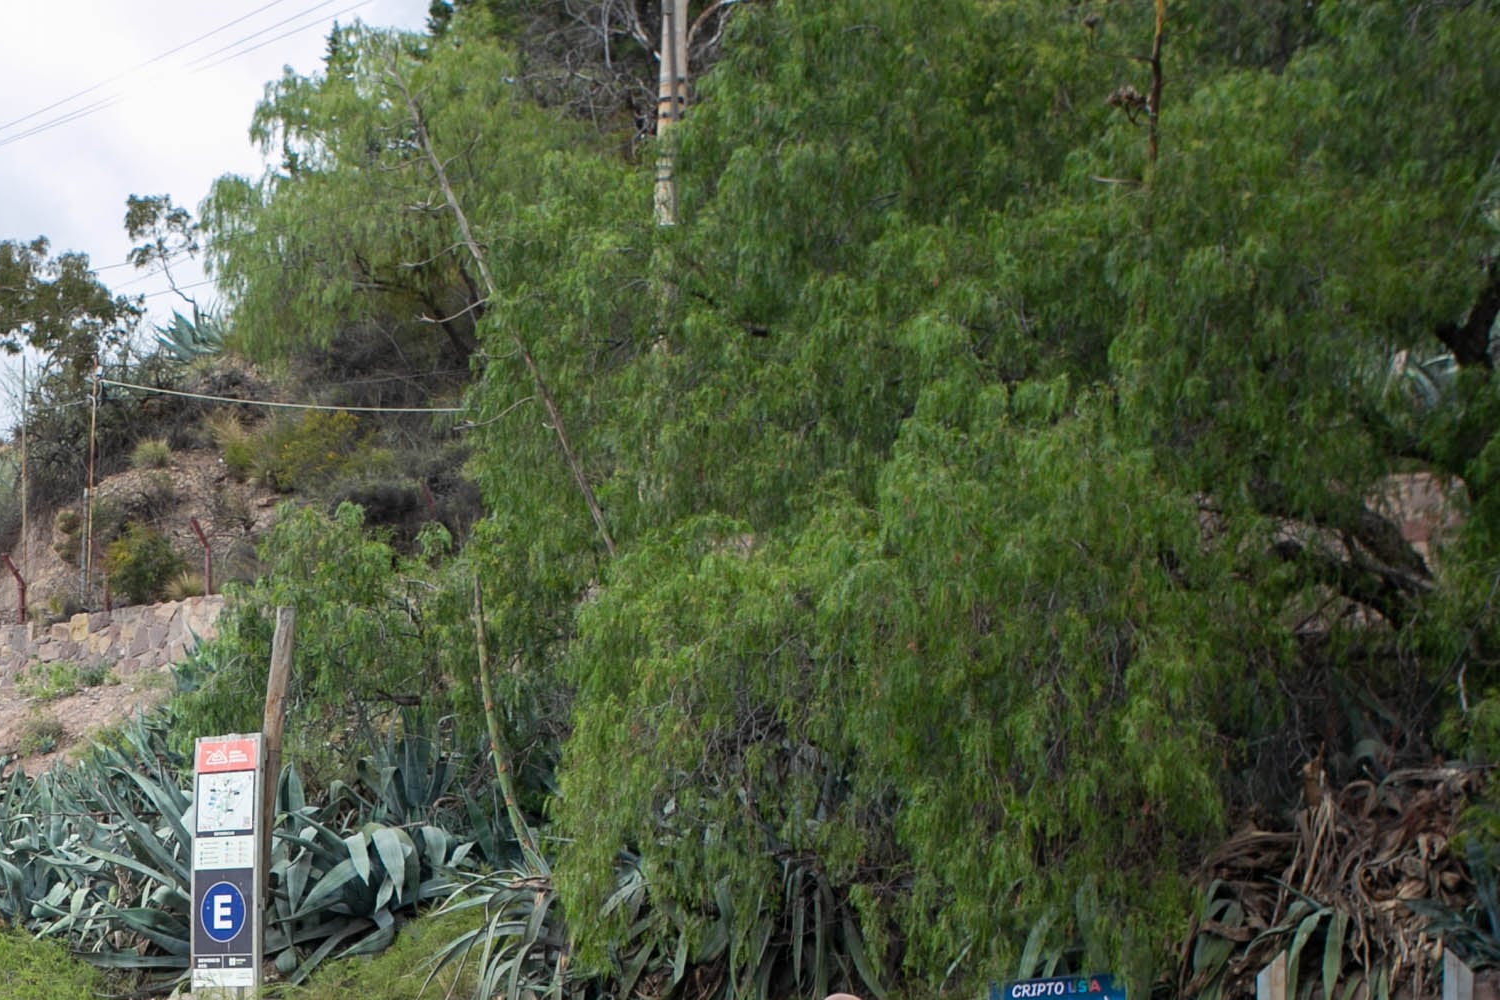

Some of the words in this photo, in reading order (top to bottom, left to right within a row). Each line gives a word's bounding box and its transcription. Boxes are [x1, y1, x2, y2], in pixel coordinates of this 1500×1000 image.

[213, 894, 233, 930] E
[1012, 982, 1064, 998] CRIPTO
[1068, 980, 1101, 993] LSA
